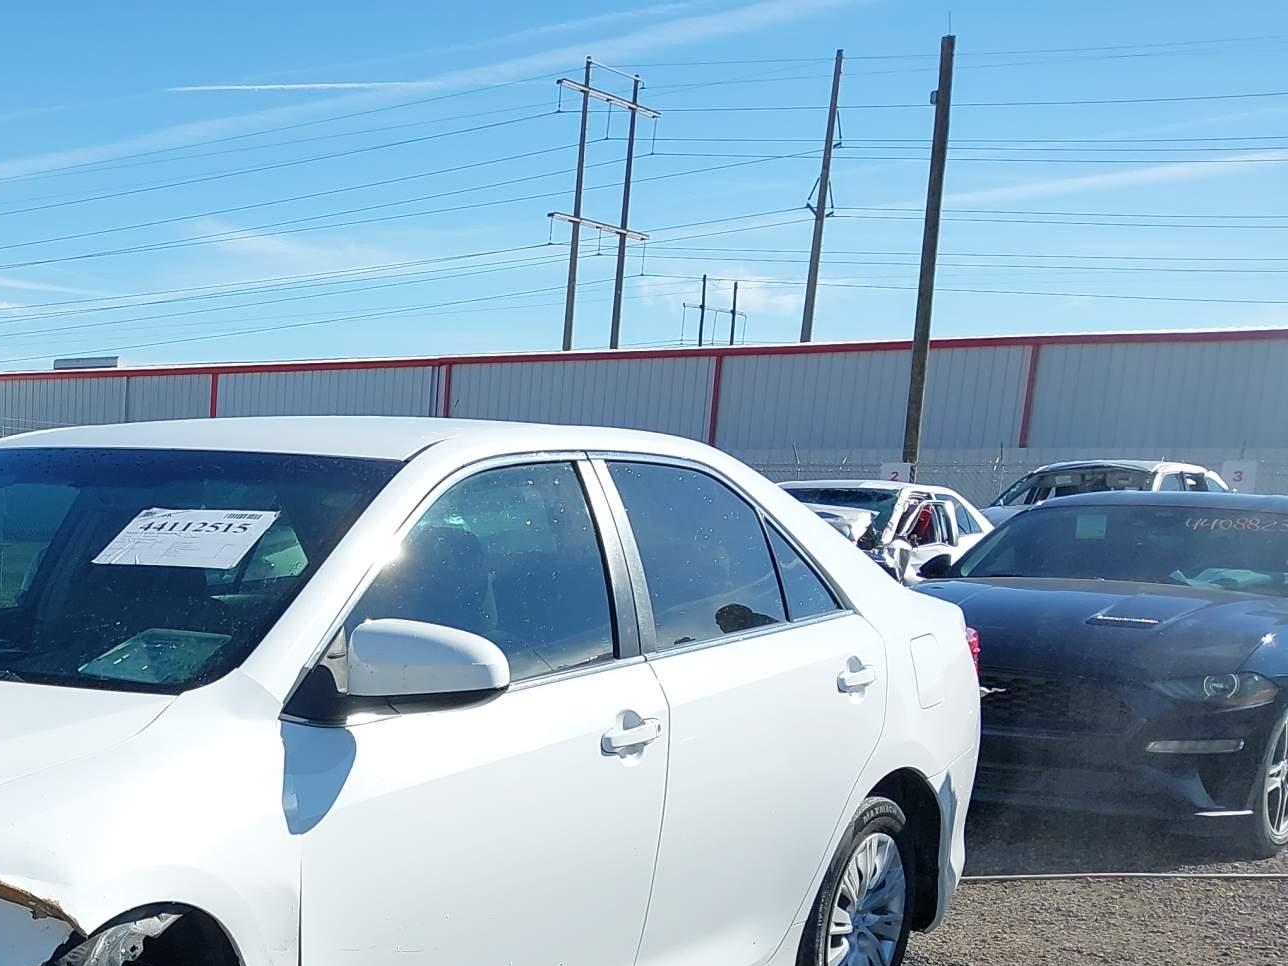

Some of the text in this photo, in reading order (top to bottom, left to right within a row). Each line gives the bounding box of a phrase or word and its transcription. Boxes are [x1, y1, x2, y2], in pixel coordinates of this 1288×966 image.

[889, 471, 900, 481] 2
[1233, 470, 1244, 482] 3
[139, 521, 253, 534] 44112515
